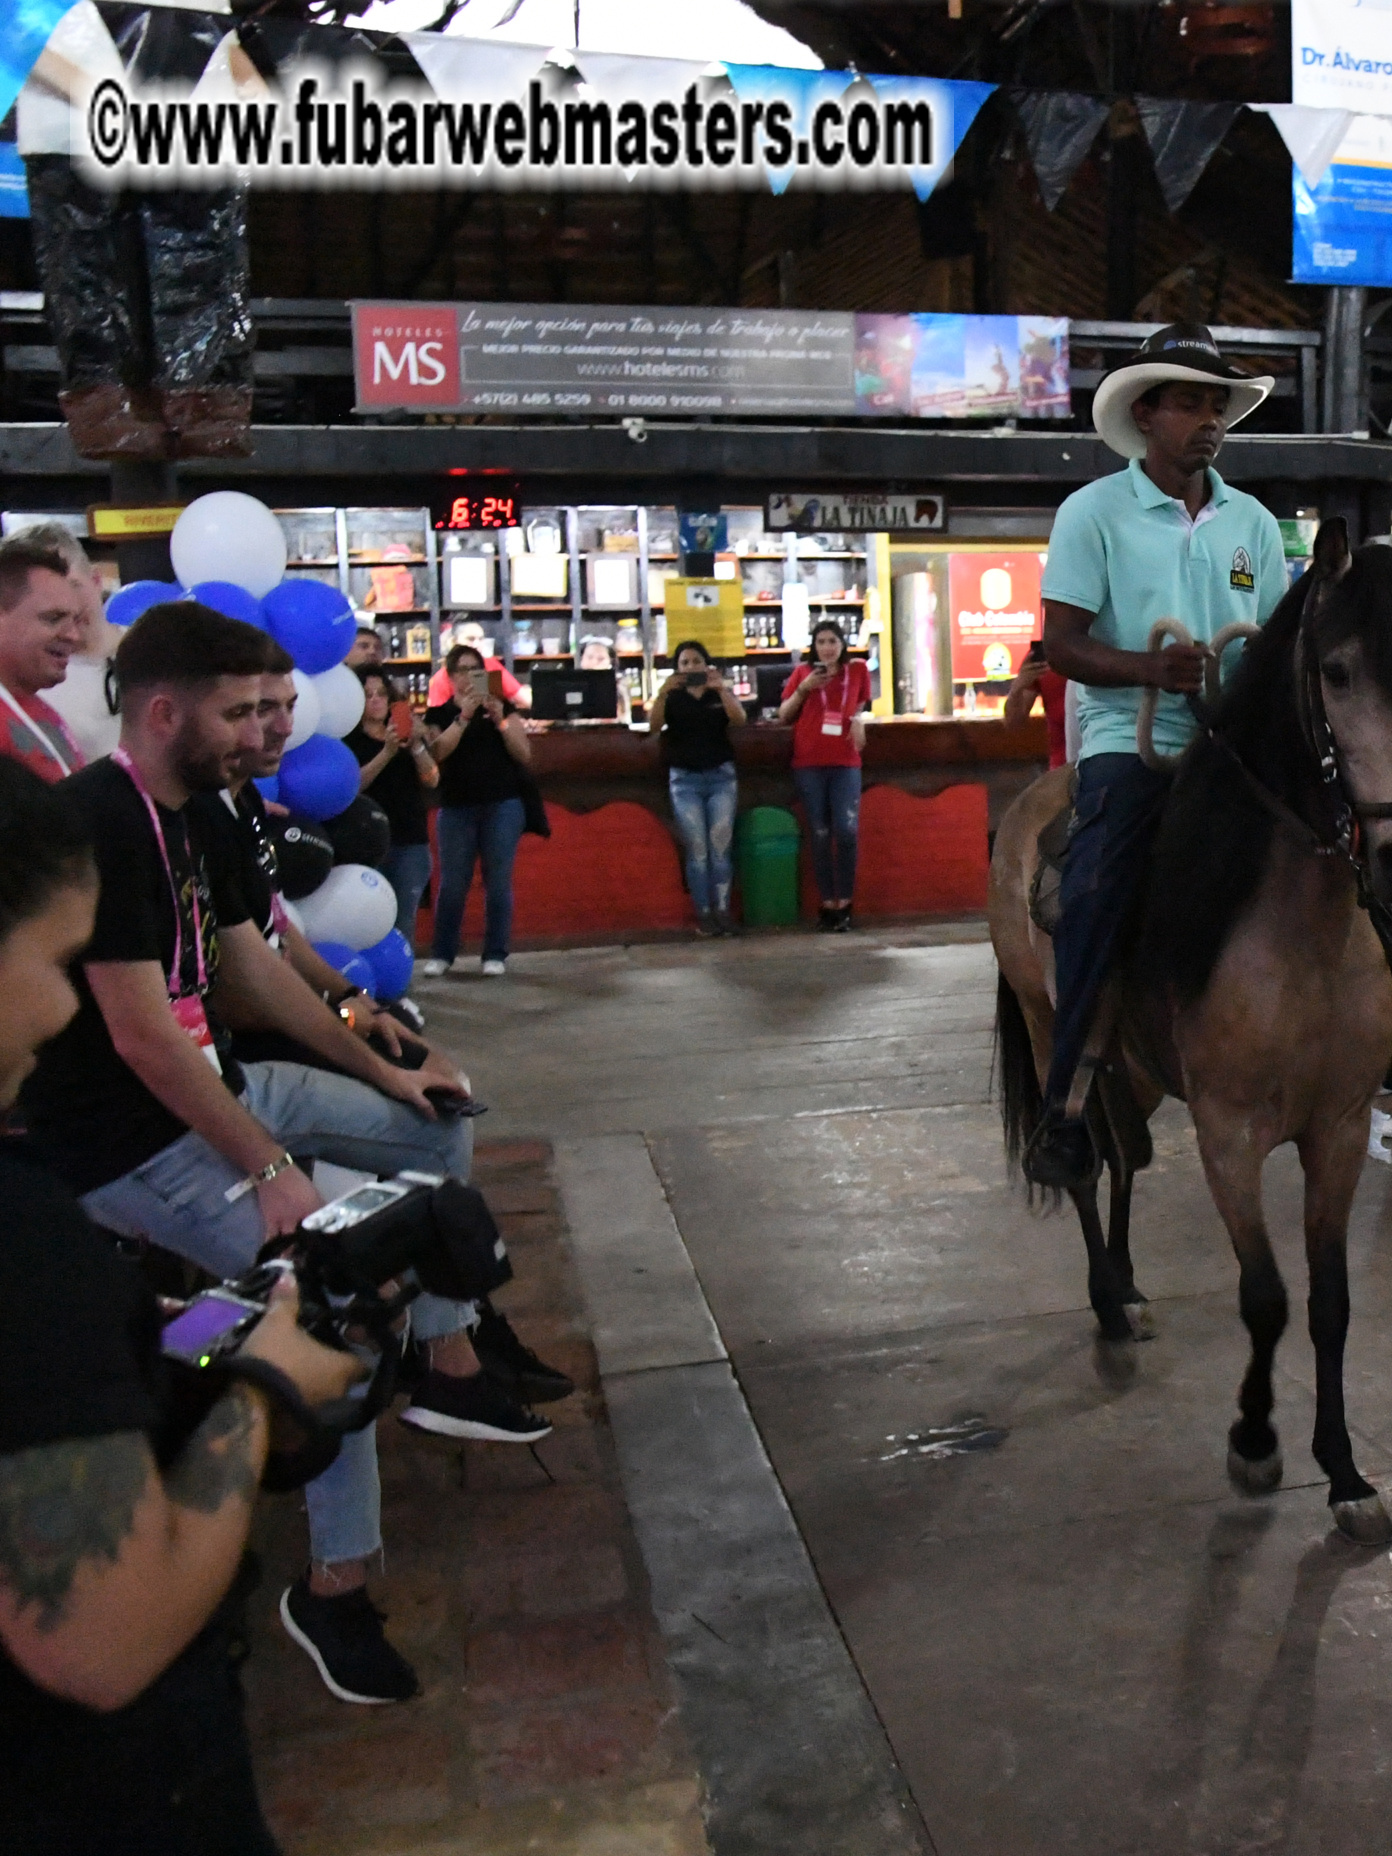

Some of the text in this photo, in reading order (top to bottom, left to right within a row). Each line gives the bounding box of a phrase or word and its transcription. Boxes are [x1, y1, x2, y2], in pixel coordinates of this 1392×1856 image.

[372, 326, 443, 338] HOTELES
[460, 309, 482, 333] La
[484, 316, 533, 339] mejor
[534, 317, 587, 339] opción
[584, 321, 627, 340] para
[657, 320, 702, 341] viajes
[705, 318, 729, 335] de
[729, 319, 785, 344] trabajo
[797, 321, 850, 345] placer
[373, 342, 446, 385] MS
[820, 506, 910, 528] LA TINAJA
